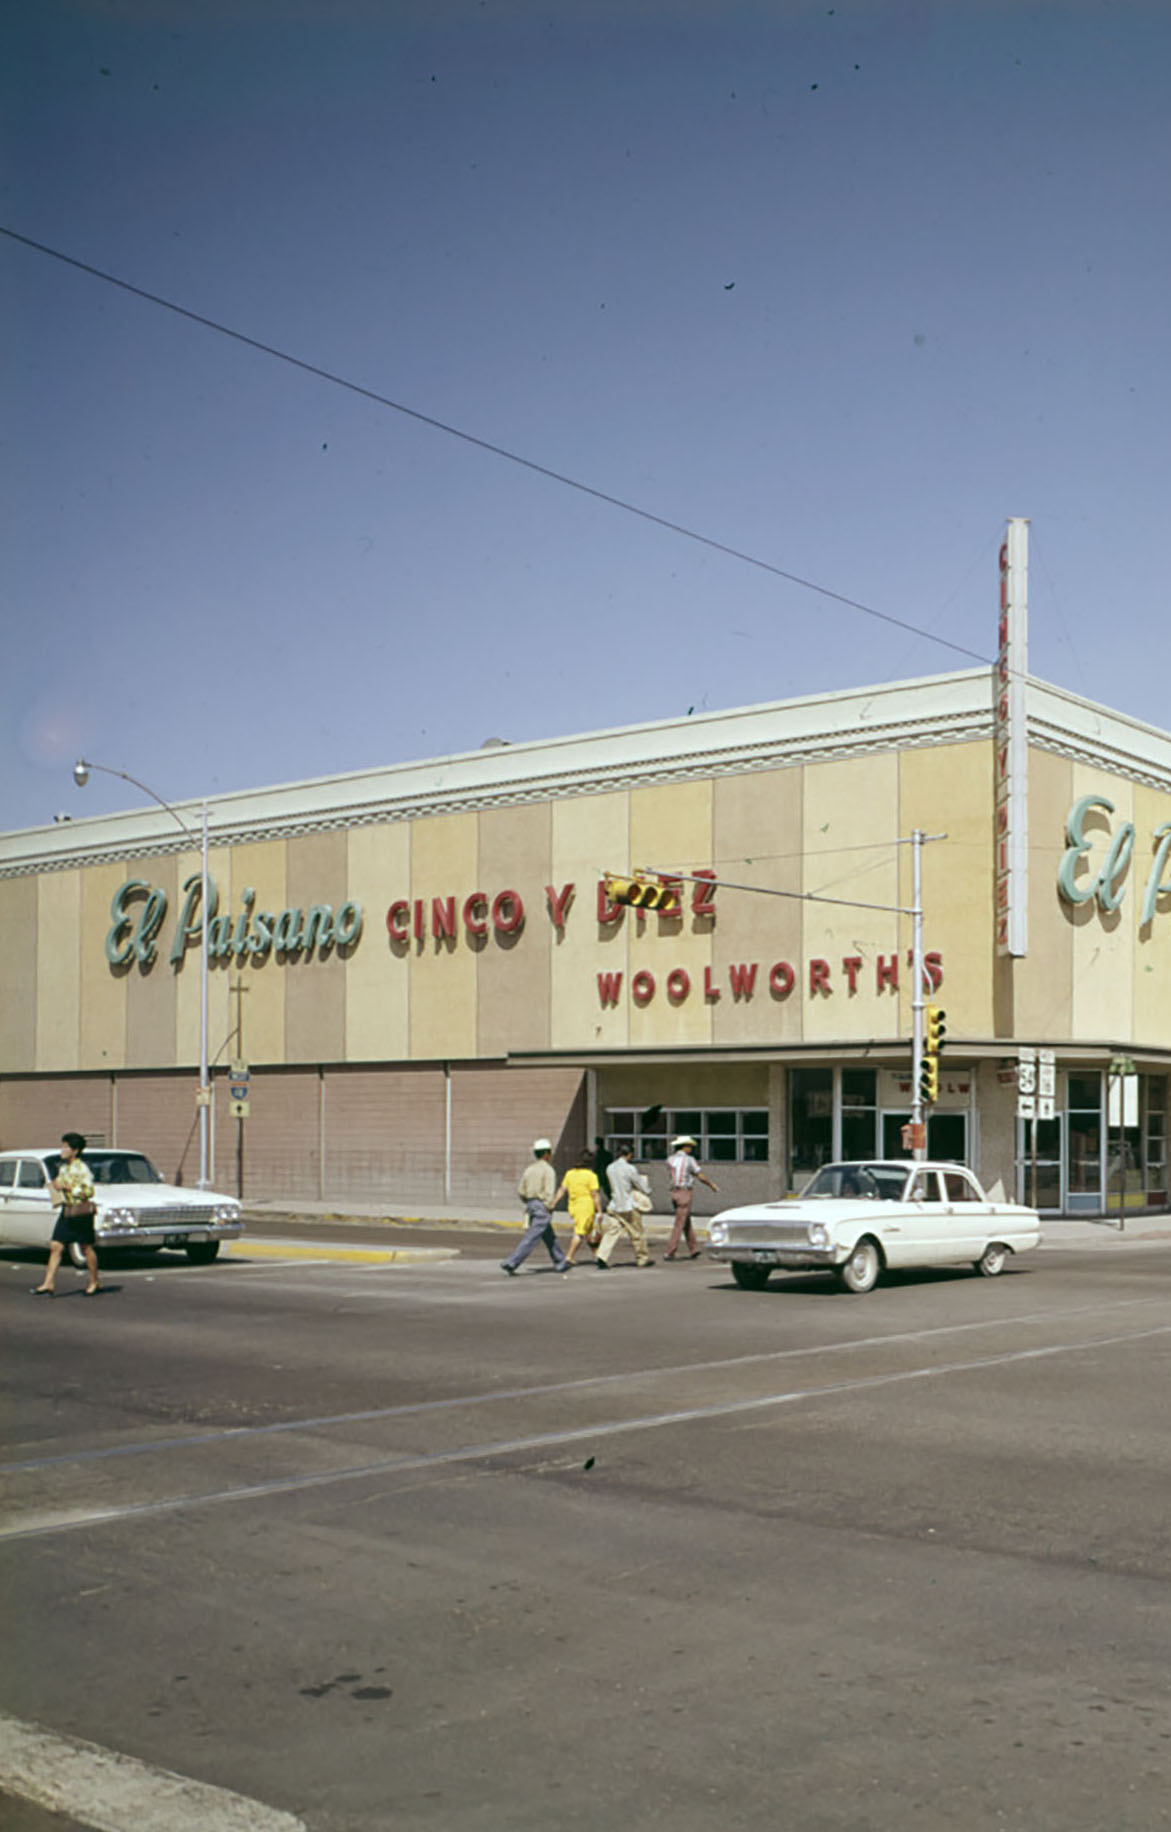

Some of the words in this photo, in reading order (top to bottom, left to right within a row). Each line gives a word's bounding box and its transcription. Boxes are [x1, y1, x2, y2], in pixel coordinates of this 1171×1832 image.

[1057, 795, 1136, 912] El
[104, 878, 167, 964] El
[170, 871, 362, 966] Paisano
[386, 889, 524, 941] CINCO
[545, 883, 575, 927] Y
[596, 949, 944, 1004] WOOLWORTH'S
